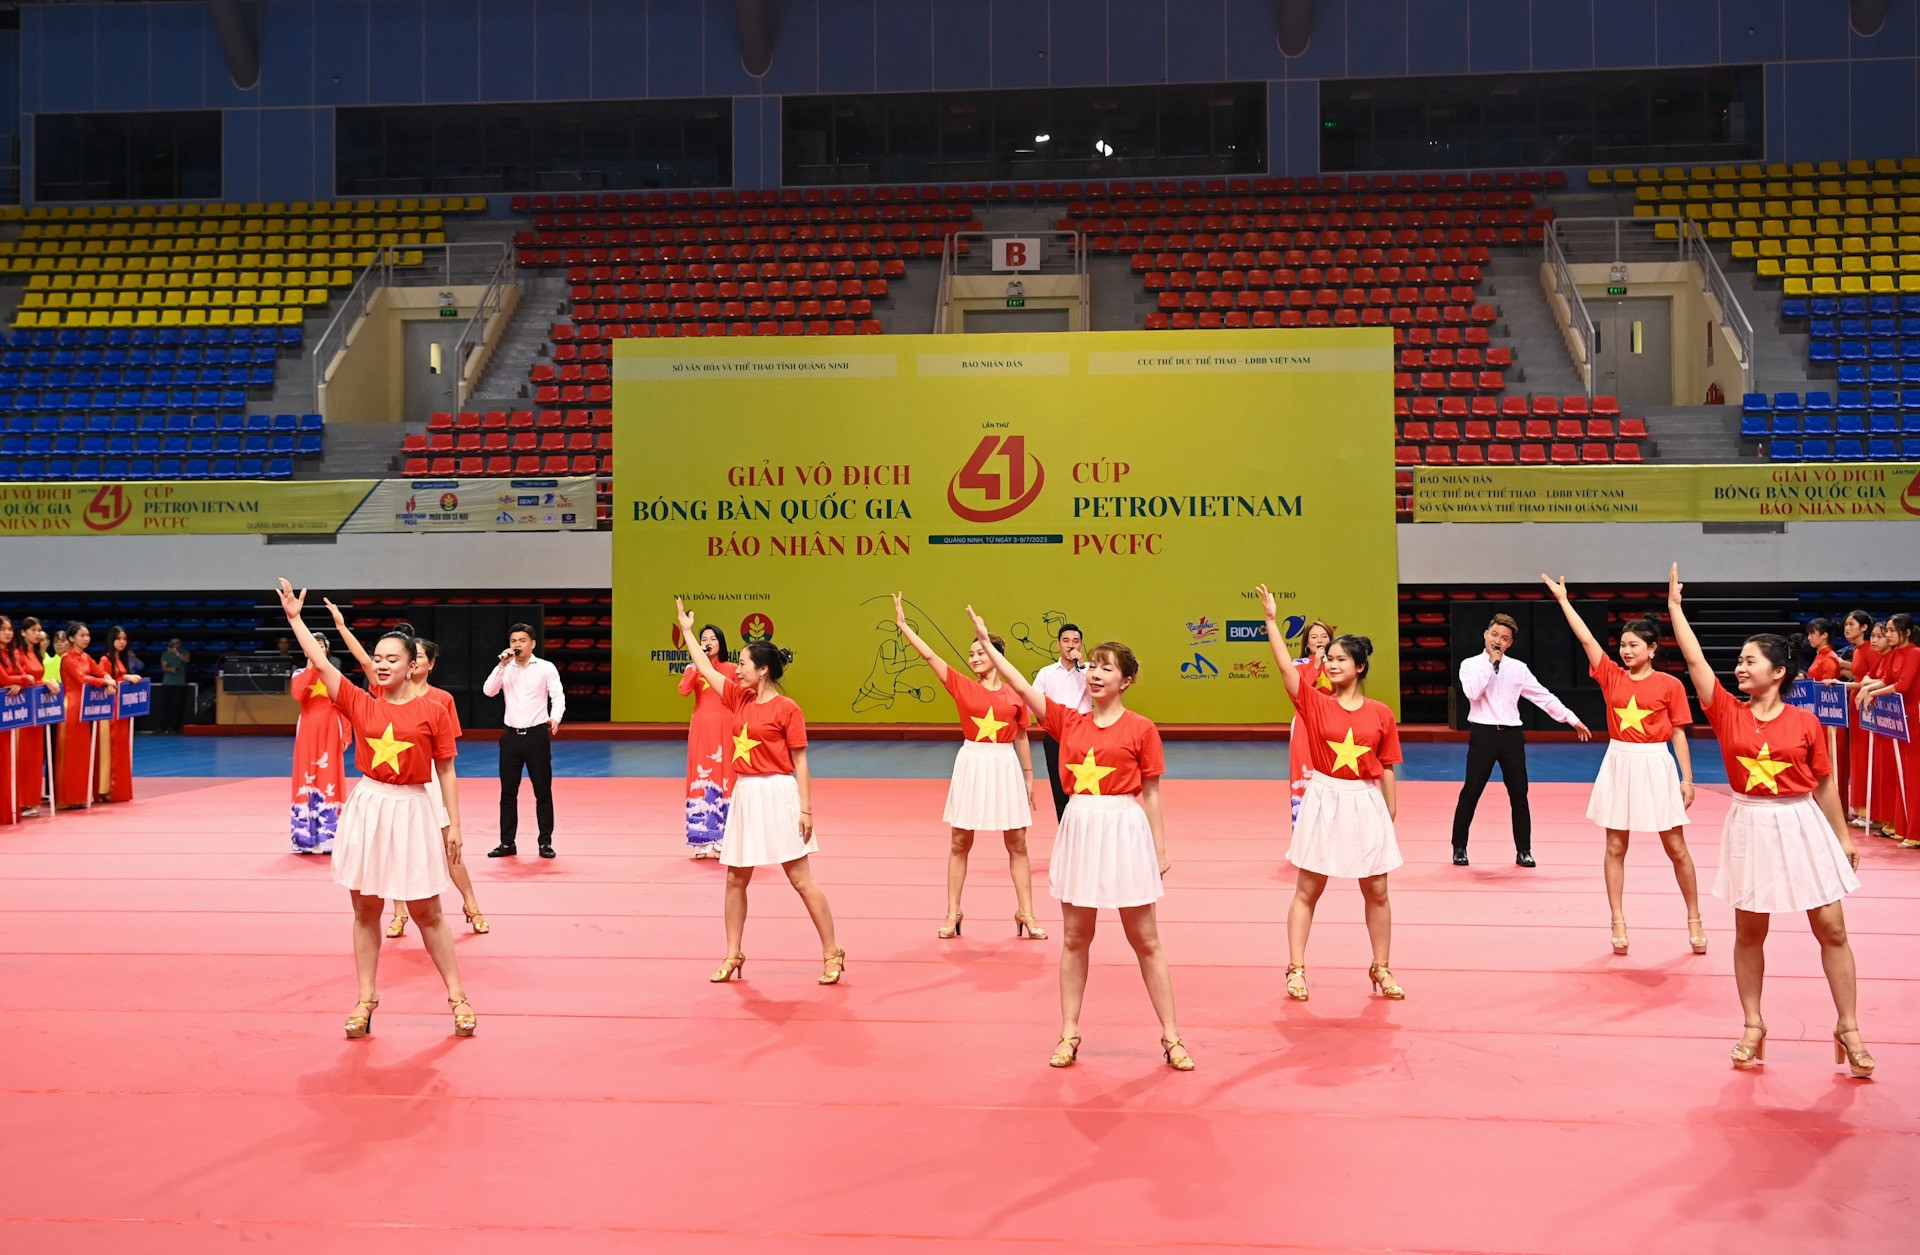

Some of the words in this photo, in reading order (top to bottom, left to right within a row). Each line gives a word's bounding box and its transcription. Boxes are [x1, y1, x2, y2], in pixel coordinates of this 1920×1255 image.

[1006, 242, 1026, 266] B
[752, 362, 774, 370] THAO
[828, 362, 850, 370] NINH
[1214, 357, 1237, 365] THAO
[1290, 356, 1311, 364] NAM
[728, 458, 786, 487] GIẢI
[794, 460, 832, 486] VÔ
[842, 464, 912, 490] ĐỊCH
[959, 435, 1024, 500] 41
[1072, 456, 1131, 484] CÚP
[1814, 467, 1836, 482] VÔ
[1442, 475, 1470, 484] NHÂN
[1472, 475, 1493, 484] DÂN
[12, 486, 32, 500] VÔ
[1509, 490, 1536, 498] THAO
[1600, 490, 1624, 498] NAM
[1715, 484, 1760, 499] BÓNG
[1766, 484, 1799, 498] BÀN
[1804, 482, 1852, 501] QUỐC
[1857, 486, 1886, 498] GIA
[48, 504, 72, 514] GIA
[90, 484, 122, 519] 41
[144, 501, 259, 514] PETROVIETNAM
[632, 496, 708, 522] BÓNG
[717, 494, 772, 520] BÀN
[780, 492, 857, 524] QUỐC
[866, 498, 912, 520] GIA
[1072, 495, 1304, 518] PETROVIETNAM
[1518, 504, 1544, 512] THAO
[1612, 504, 1638, 512] NINH
[1760, 500, 1792, 515] BÁO
[1798, 500, 1846, 514] NHÂN
[1852, 500, 1886, 514] DÂN
[43, 516, 71, 530] DÂN
[144, 517, 190, 529] PVCFC
[708, 531, 760, 557] BÁO
[769, 530, 846, 556] NHÂN
[856, 530, 912, 556] DÂN
[1072, 533, 1164, 556] PVCFC
[1230, 626, 1258, 638] BIDV
